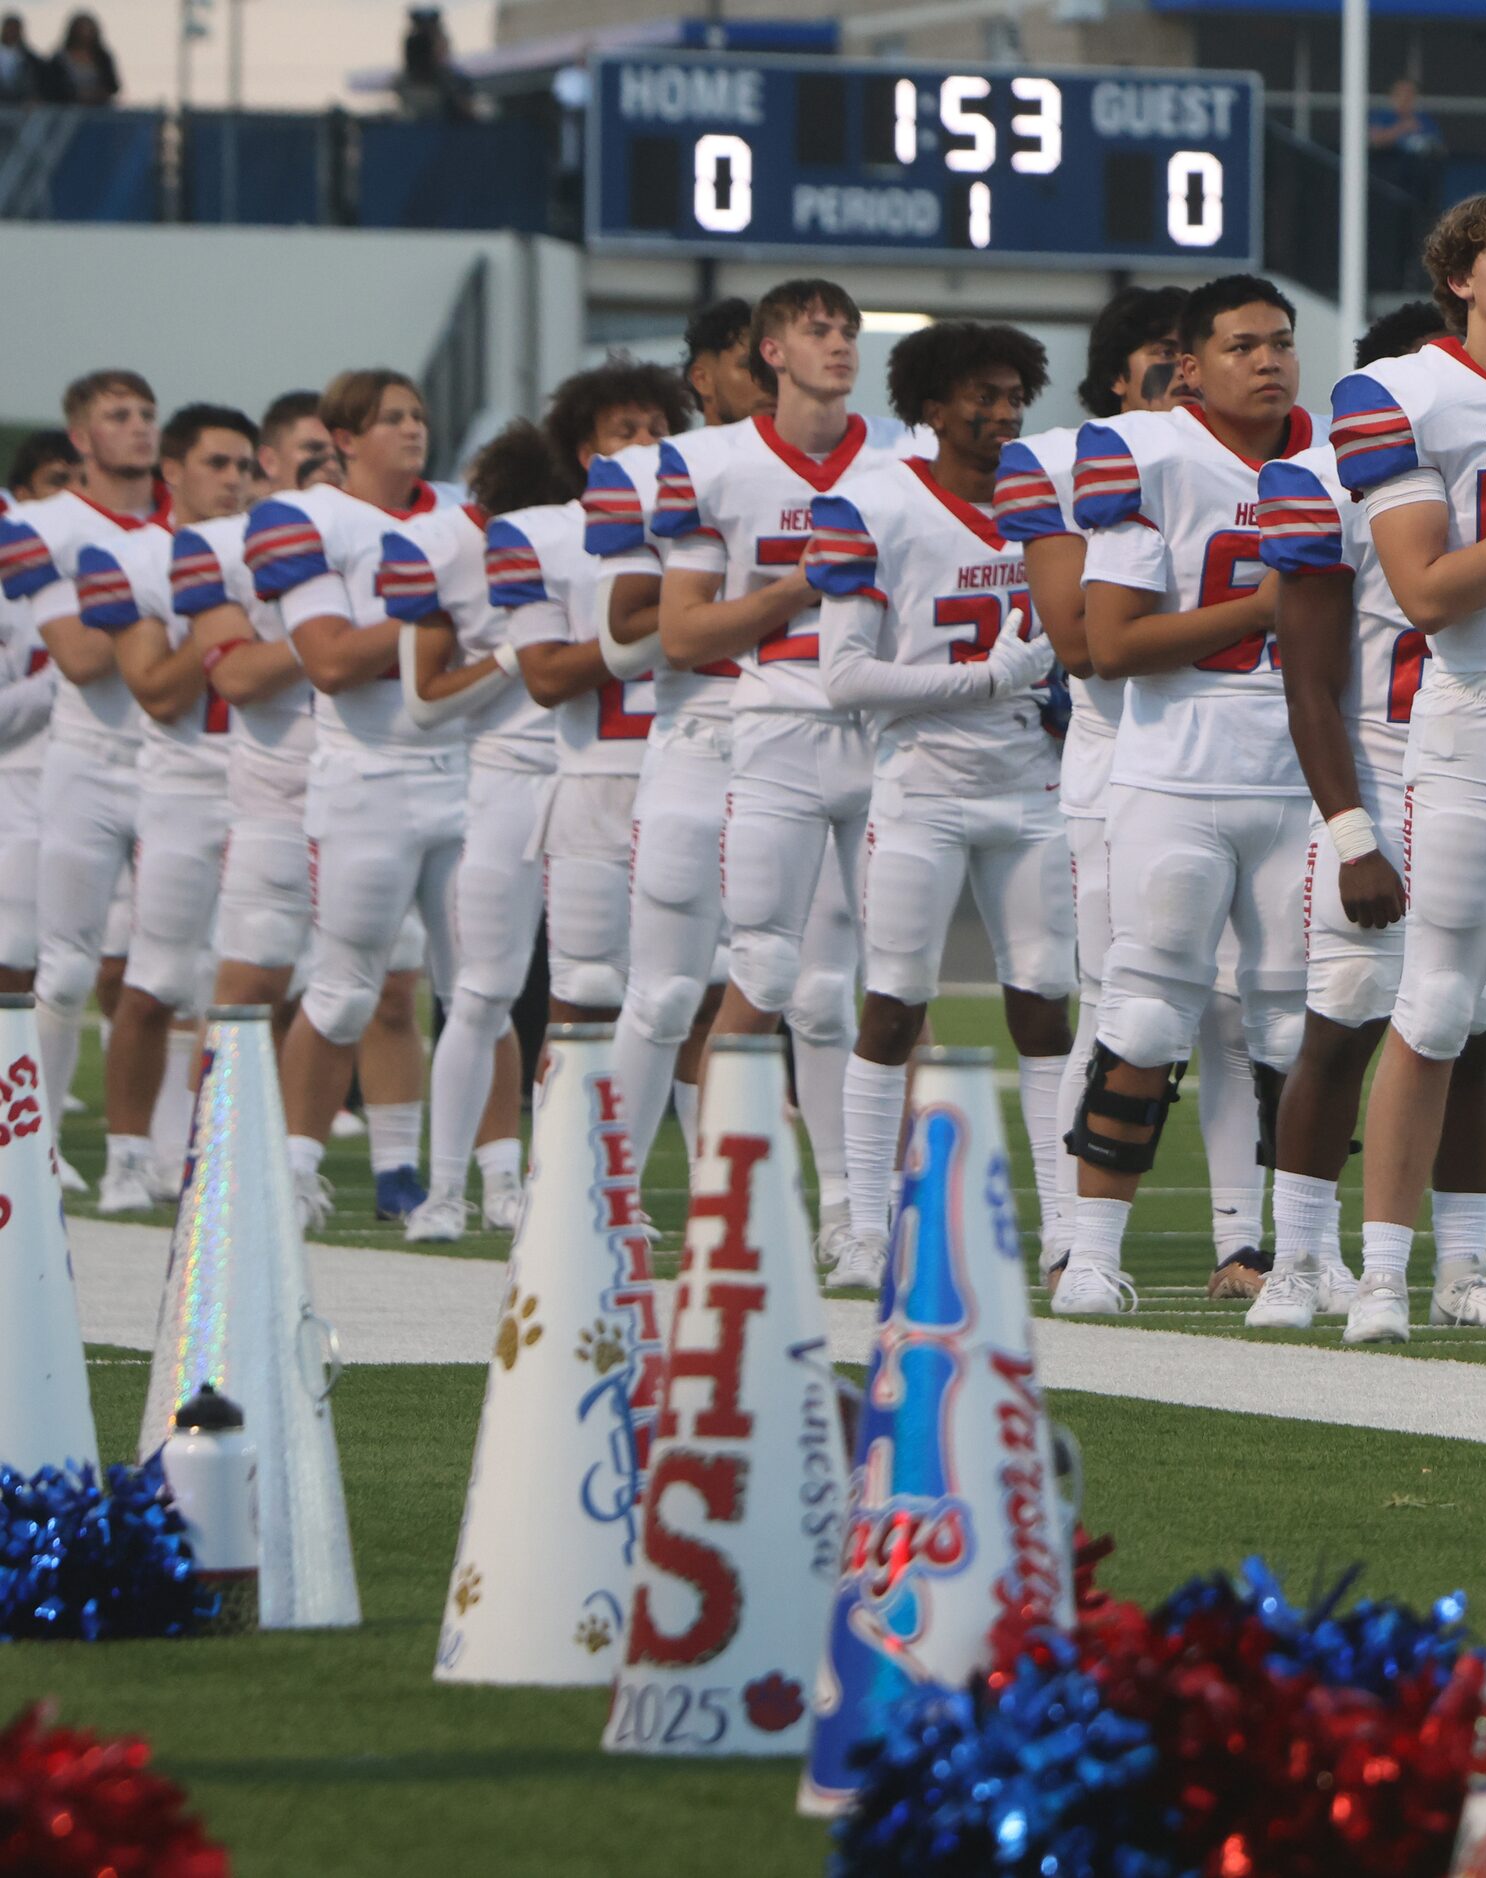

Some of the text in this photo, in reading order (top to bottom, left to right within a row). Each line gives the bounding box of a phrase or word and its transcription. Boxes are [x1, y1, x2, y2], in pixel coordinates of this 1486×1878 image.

[618, 67, 766, 124] HOME
[1090, 83, 1239, 139] GUEST
[694, 134, 752, 232] 0
[792, 181, 991, 249] PERIOD 1
[1167, 150, 1223, 246] 0
[627, 1132, 771, 1669] HHS
[615, 1684, 735, 1745] 2025
